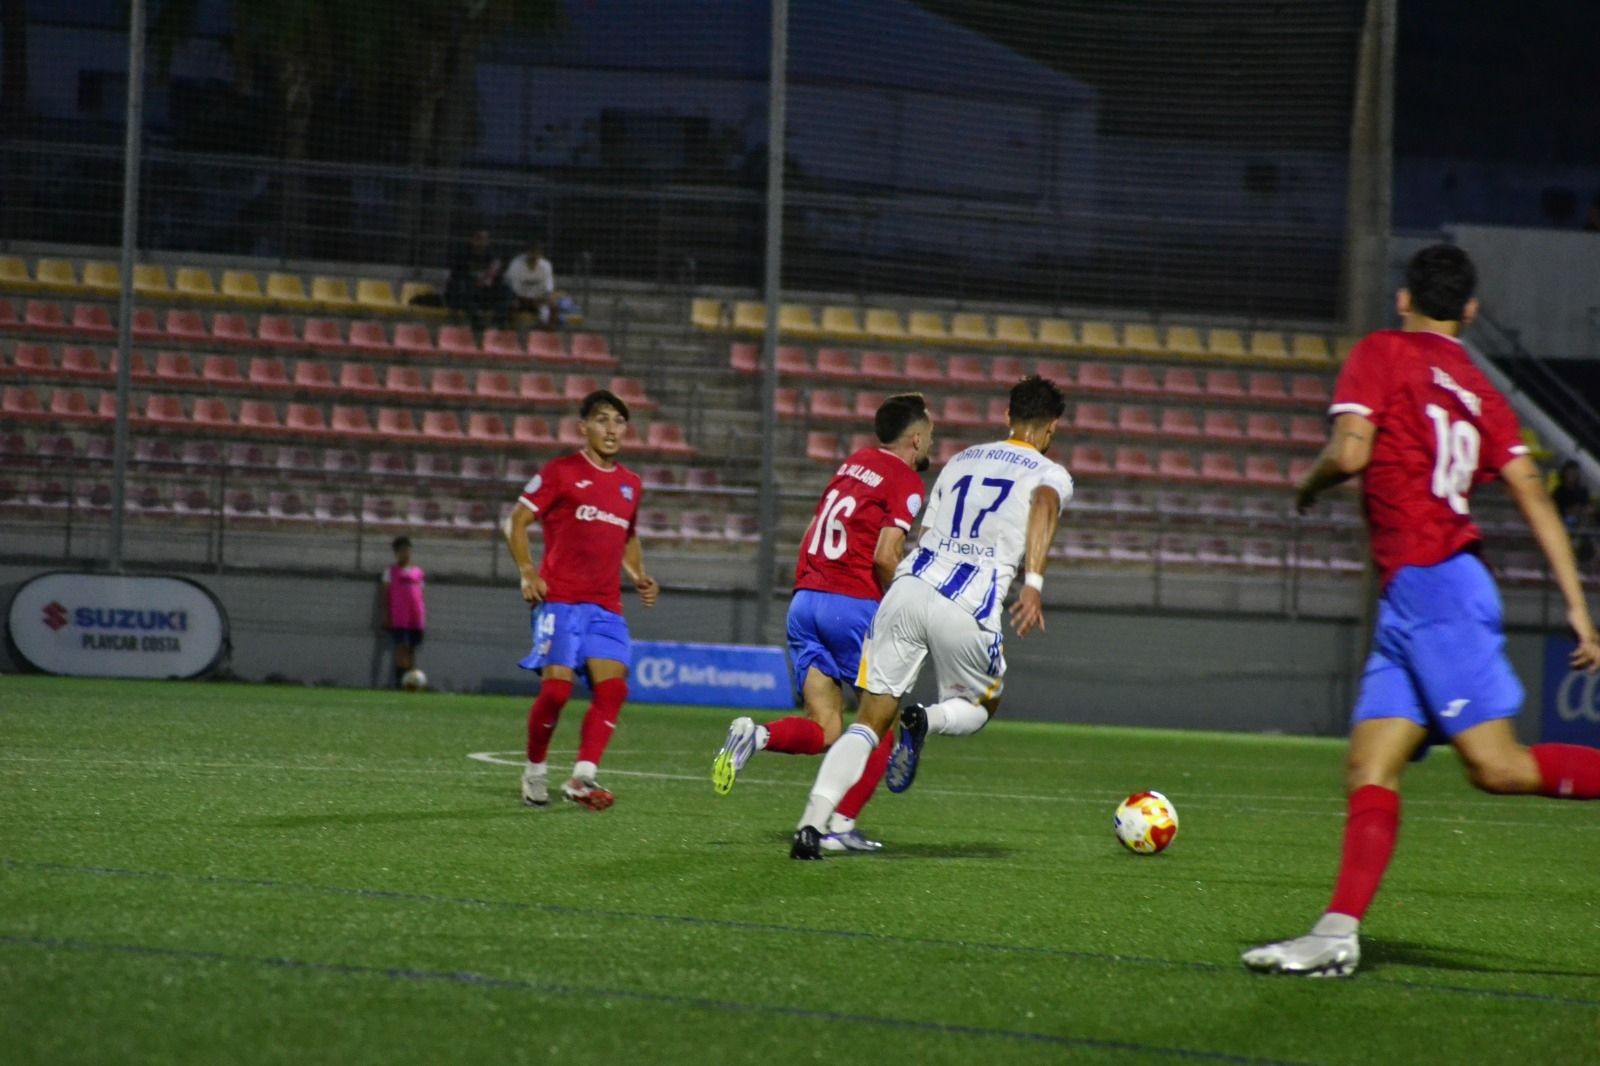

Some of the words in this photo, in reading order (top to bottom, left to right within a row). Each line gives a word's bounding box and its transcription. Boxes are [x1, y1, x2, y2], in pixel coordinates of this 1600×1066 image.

[985, 449, 1039, 470] ROMERO
[951, 474, 1015, 539] 17
[807, 488, 857, 560] 16
[938, 538, 995, 558] Huelva
[74, 606, 188, 632] SUZUKI
[81, 634, 138, 651] PLAYCAR
[141, 636, 181, 653] COSTA
